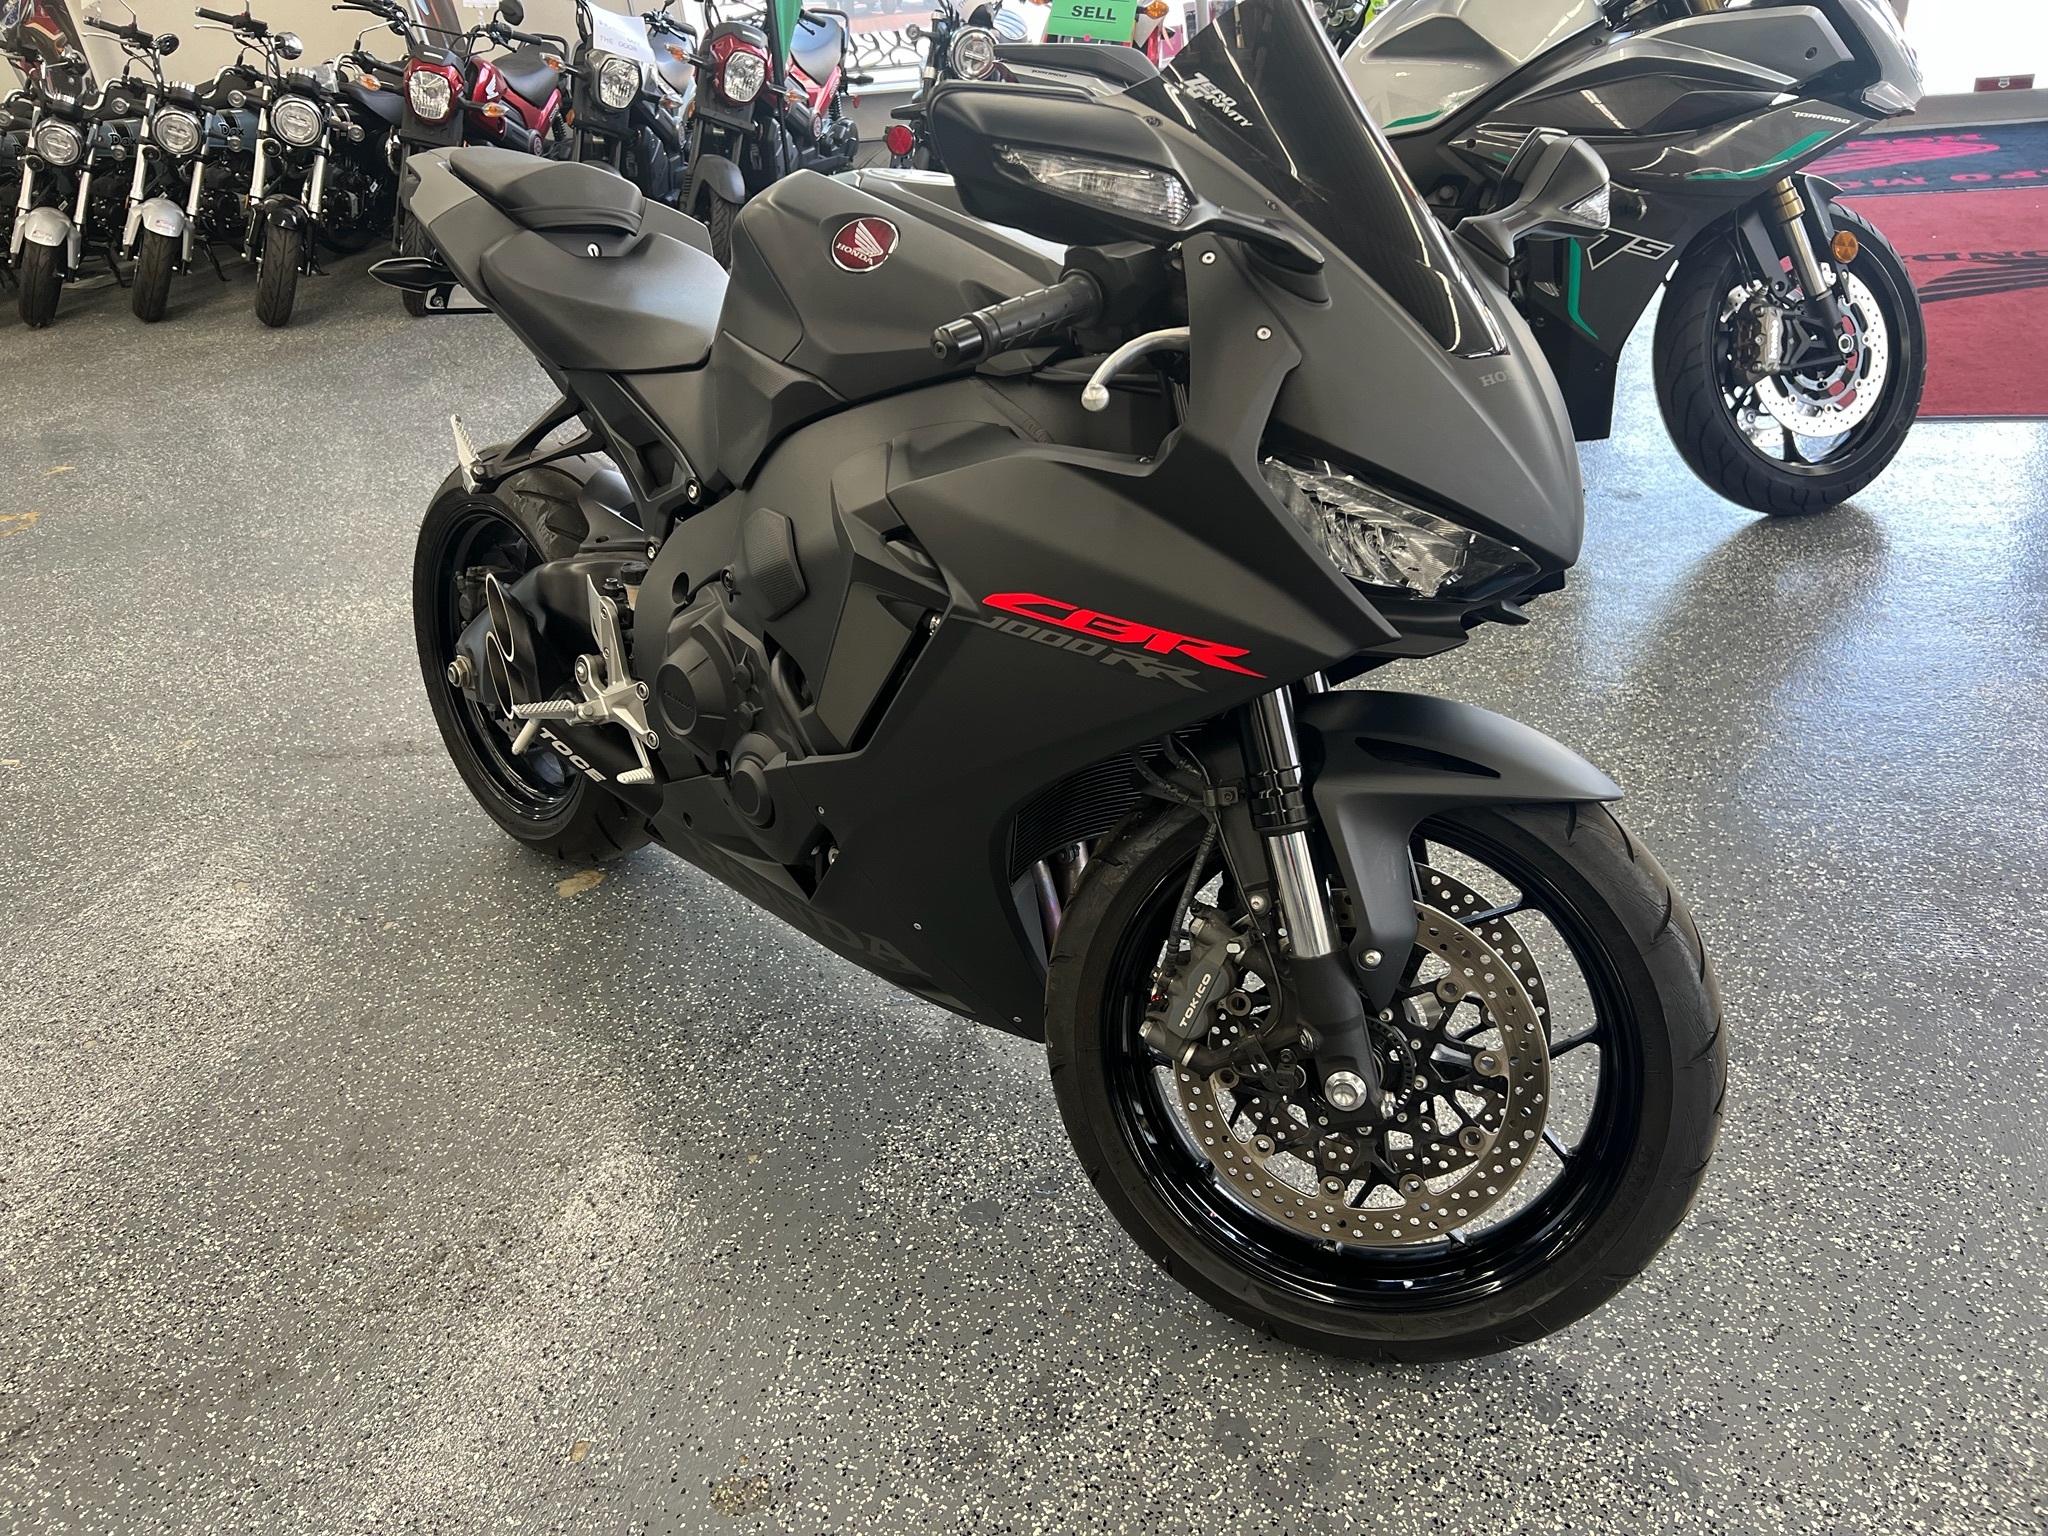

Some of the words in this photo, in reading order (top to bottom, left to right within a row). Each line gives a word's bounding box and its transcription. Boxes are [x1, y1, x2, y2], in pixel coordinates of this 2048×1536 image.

[1071, 5, 1117, 21] SELL
[599, 35, 614, 45] THE
[1183, 72, 1237, 107] ZERO
[1186, 87, 1254, 127] GRAVITY
[1791, 110, 1851, 124] TORNADO
[110, 133, 138, 147] Dax
[219, 123, 245, 137] Dax
[835, 242, 874, 266] HONDA
[982, 592, 1269, 679] CBR
[540, 727, 608, 782] TOCE
[1179, 973, 1212, 1027] TOKICO
